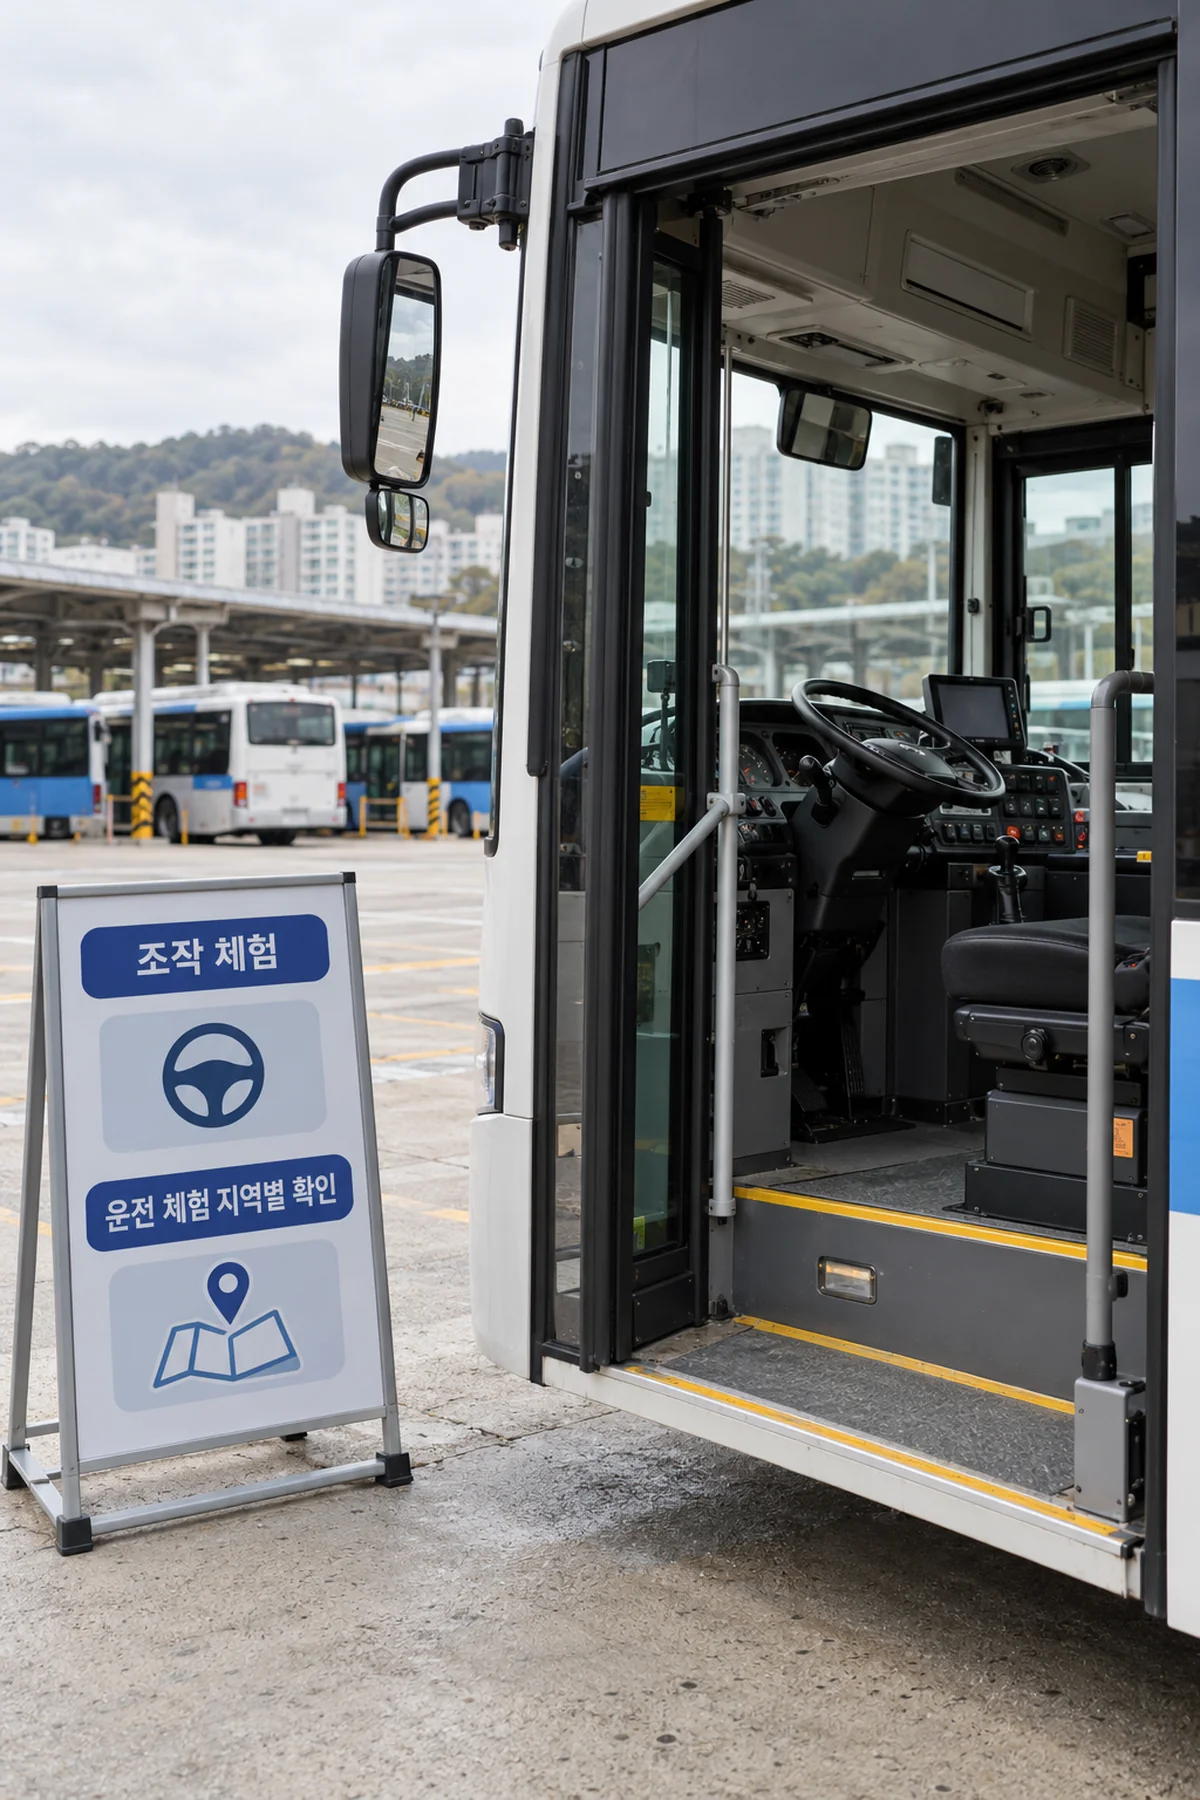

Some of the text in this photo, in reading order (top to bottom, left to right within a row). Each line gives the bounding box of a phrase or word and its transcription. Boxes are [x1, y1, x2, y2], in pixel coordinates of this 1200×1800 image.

[137, 932, 278, 976] 조작 체험
[105, 1172, 337, 1233] 운전 체험 지역별 확인
